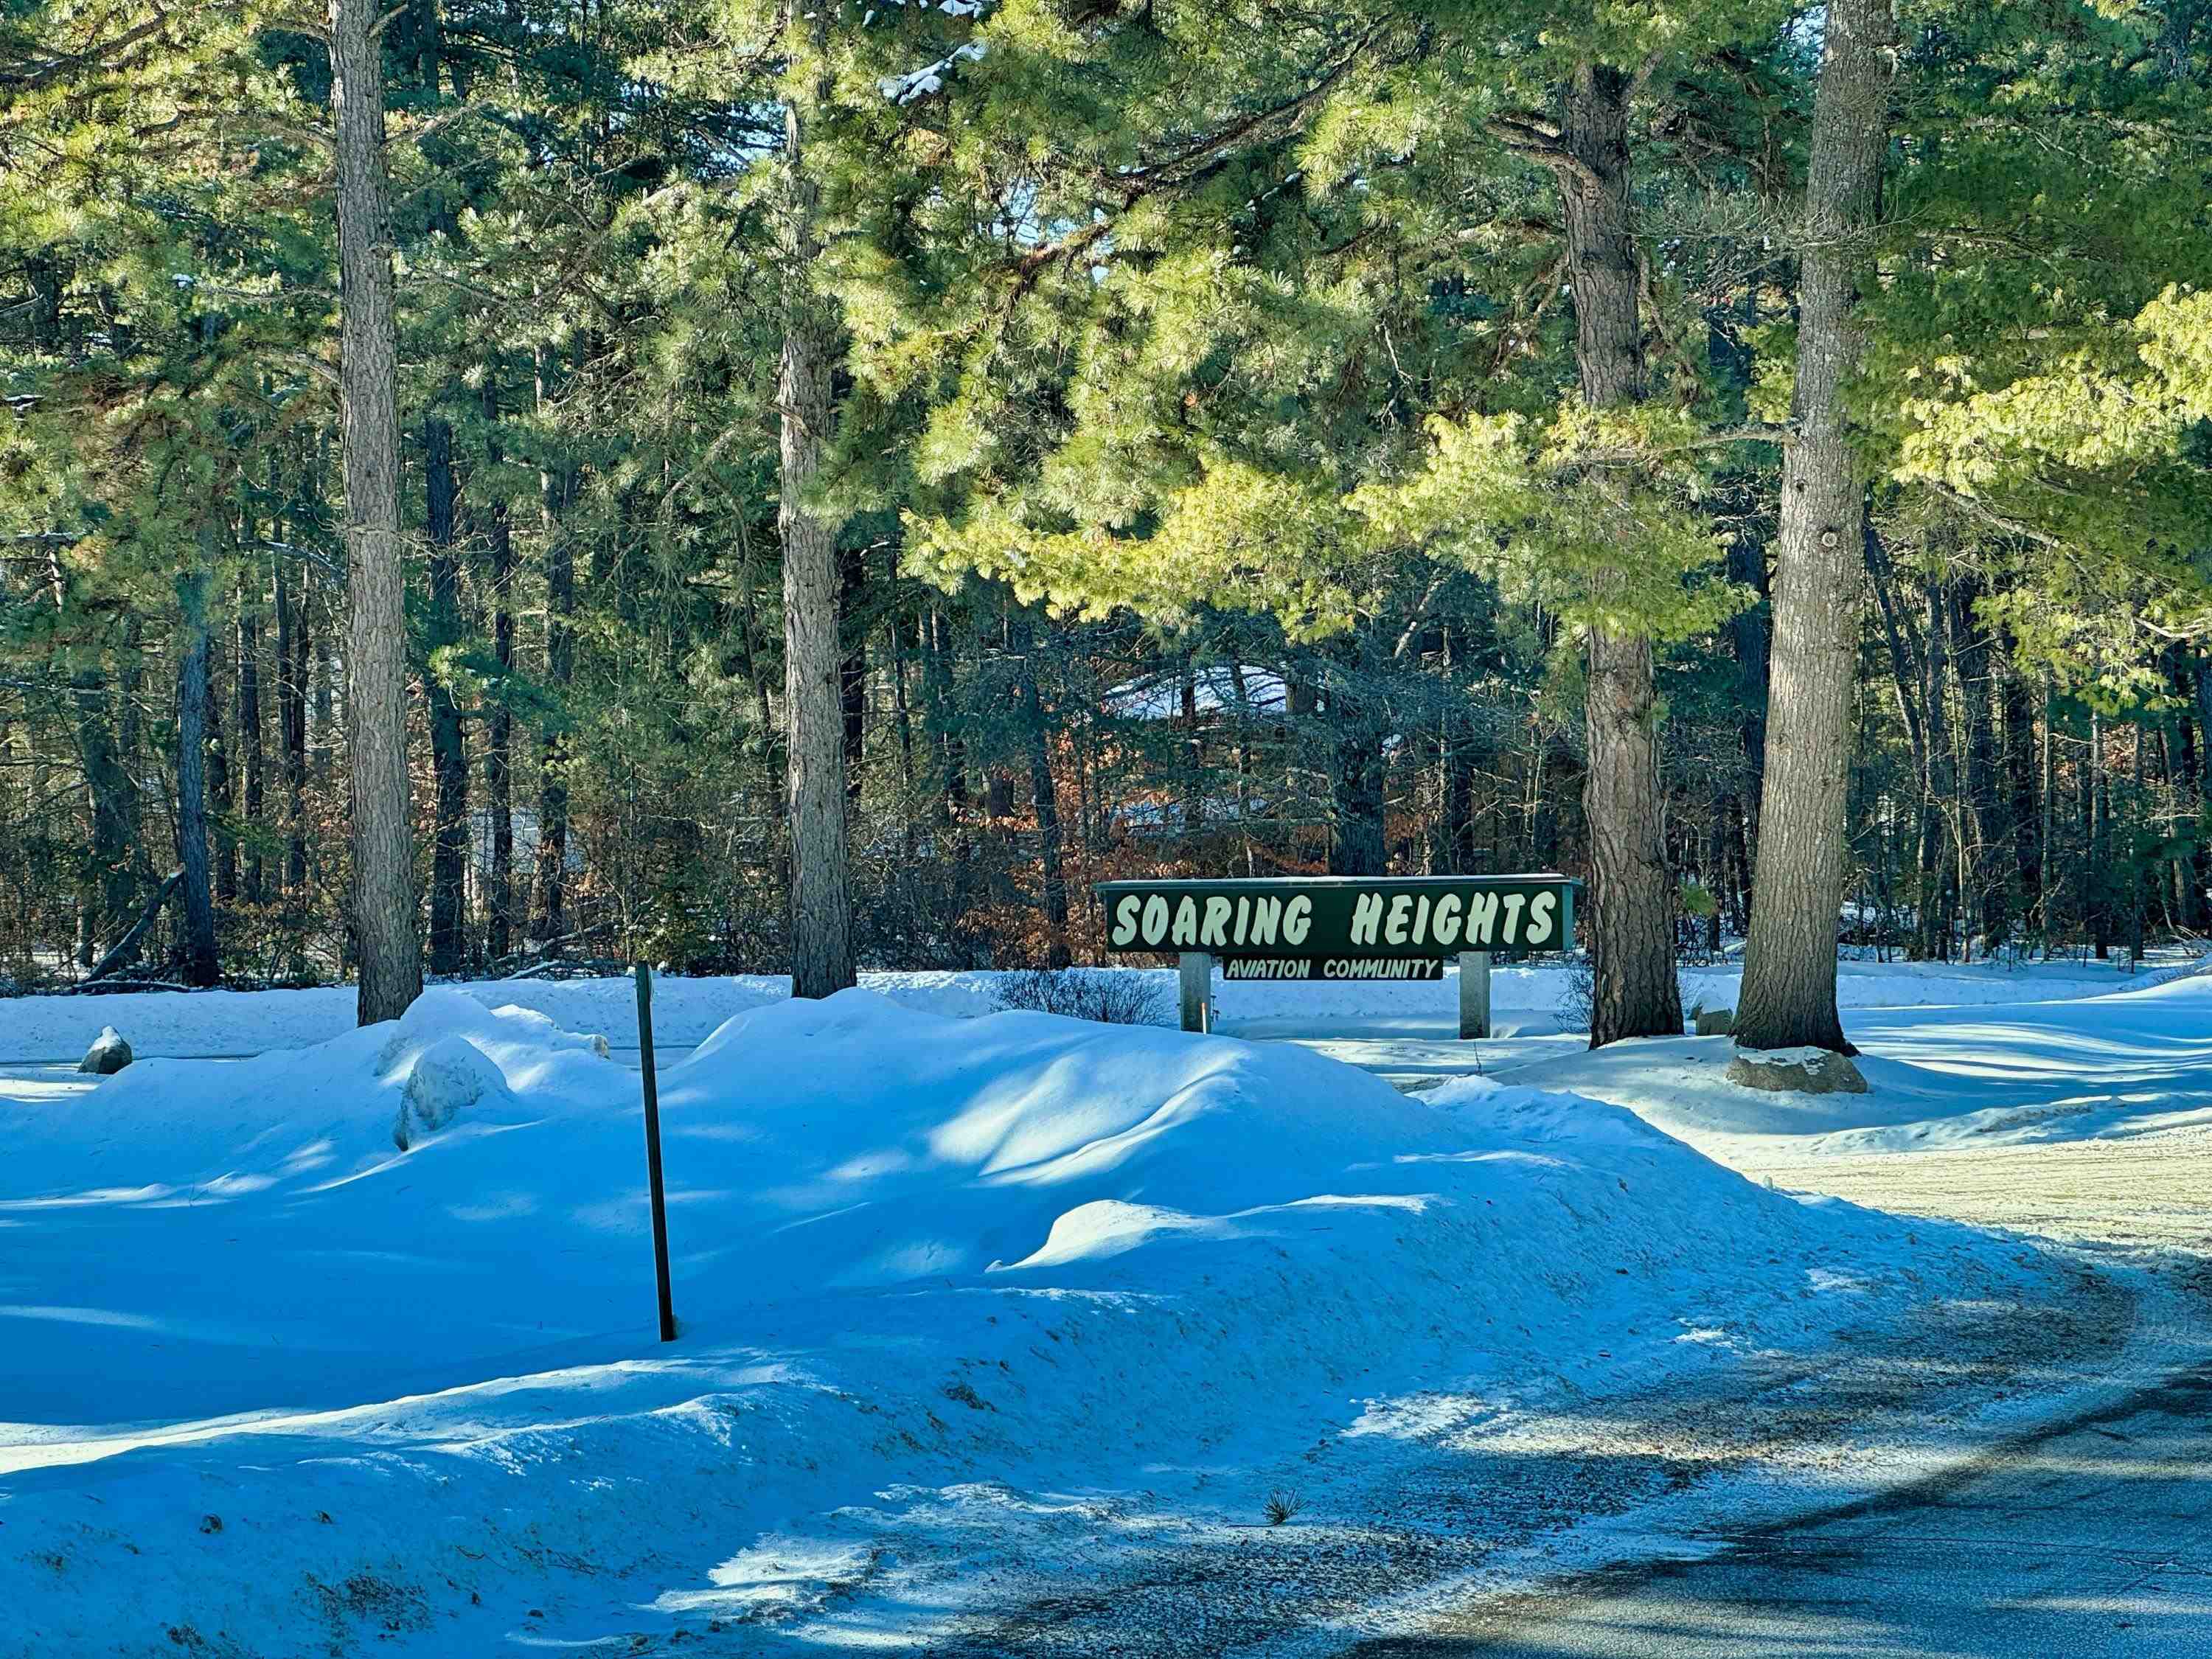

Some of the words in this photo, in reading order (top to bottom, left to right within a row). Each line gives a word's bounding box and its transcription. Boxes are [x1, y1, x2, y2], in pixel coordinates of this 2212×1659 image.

[1112, 894, 1312, 946] SOARING
[1350, 891, 1557, 945] HEIGHTS
[1225, 959, 1310, 979] AVIATION
[1324, 959, 1439, 979] COMMUNITY
